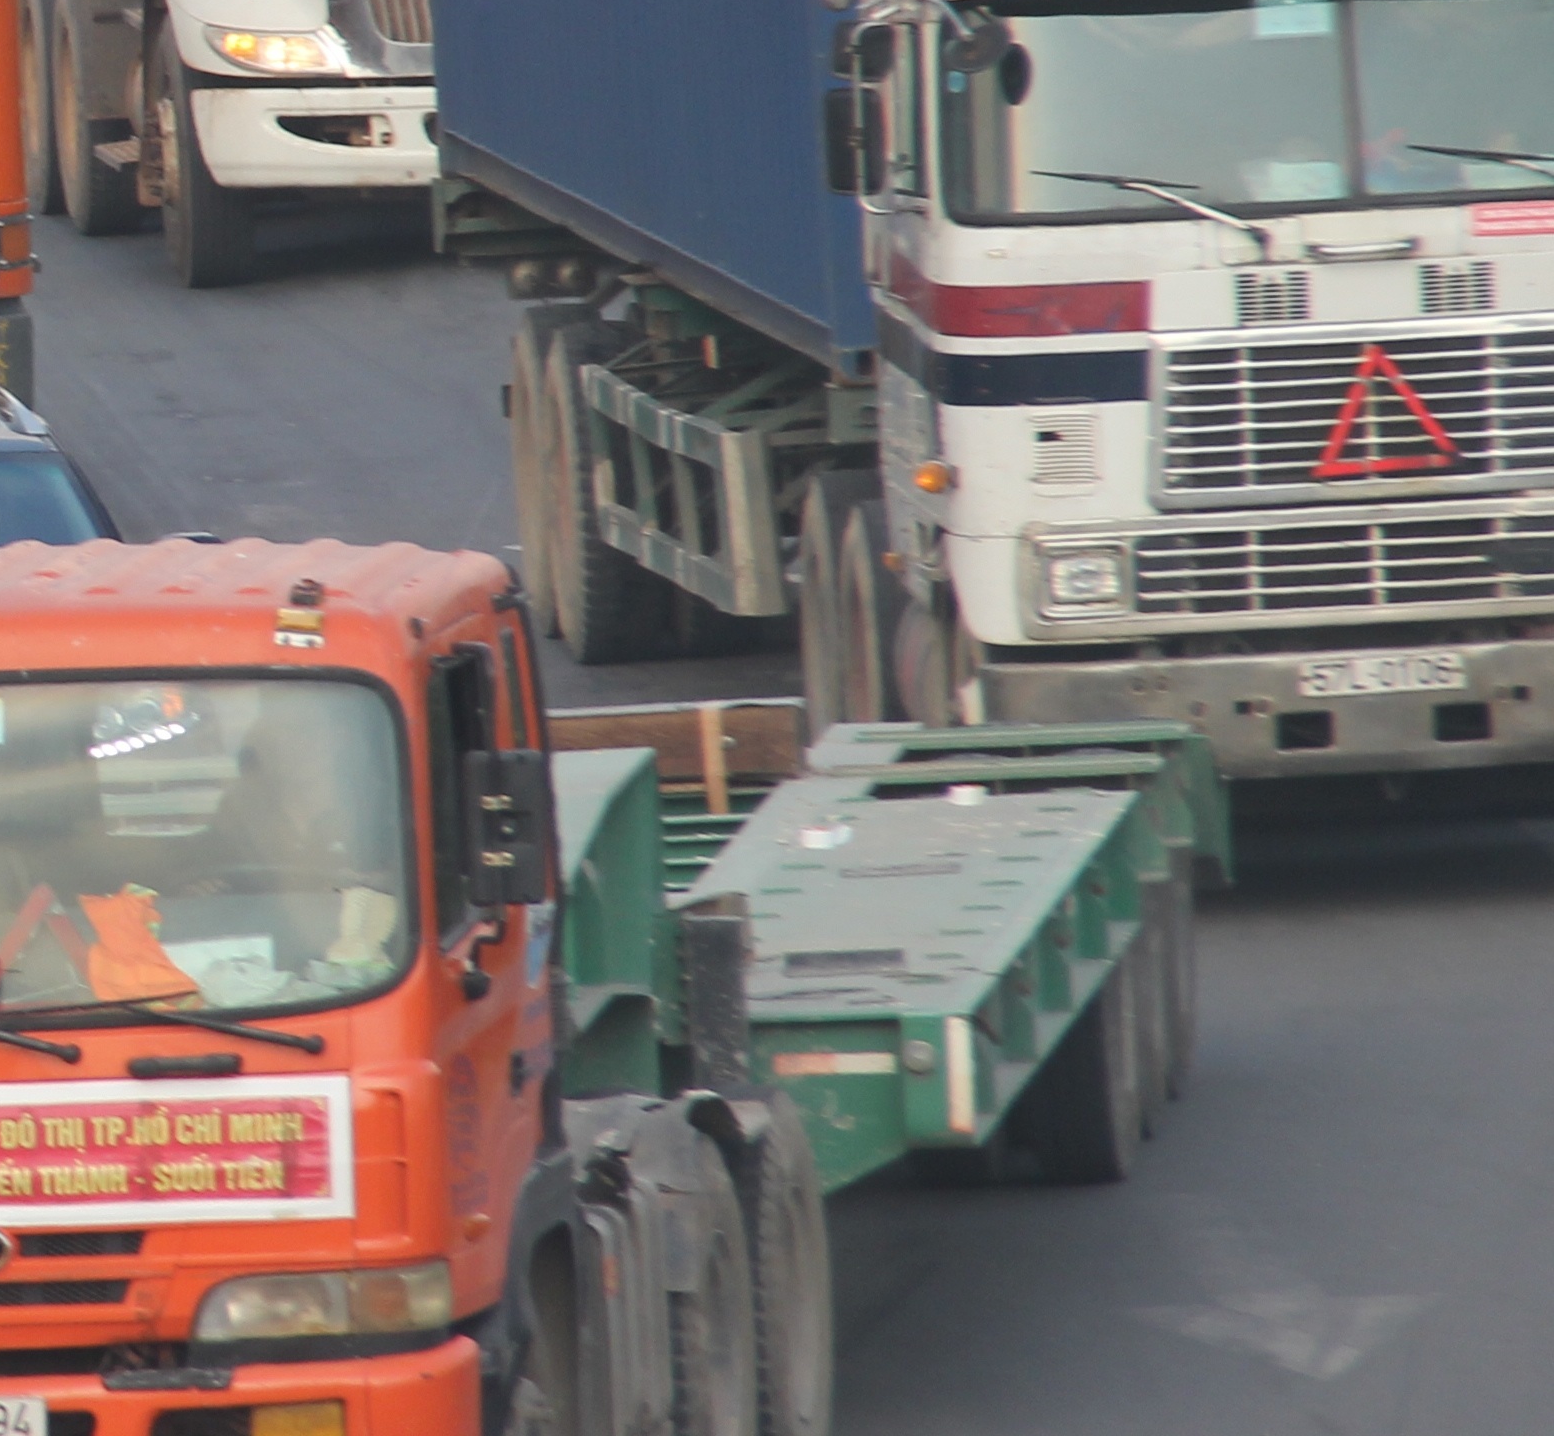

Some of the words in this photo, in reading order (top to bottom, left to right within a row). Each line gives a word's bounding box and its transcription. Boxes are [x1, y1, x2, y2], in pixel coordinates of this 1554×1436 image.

[41, 1117, 87, 1154] THỊ
[174, 1107, 223, 1145] CHÍ
[228, 1112, 305, 1144] MINH
[36, 1157, 129, 1196] THÀNH
[152, 1153, 218, 1194] SUỐI
[221, 1155, 286, 1191] TIÊN
